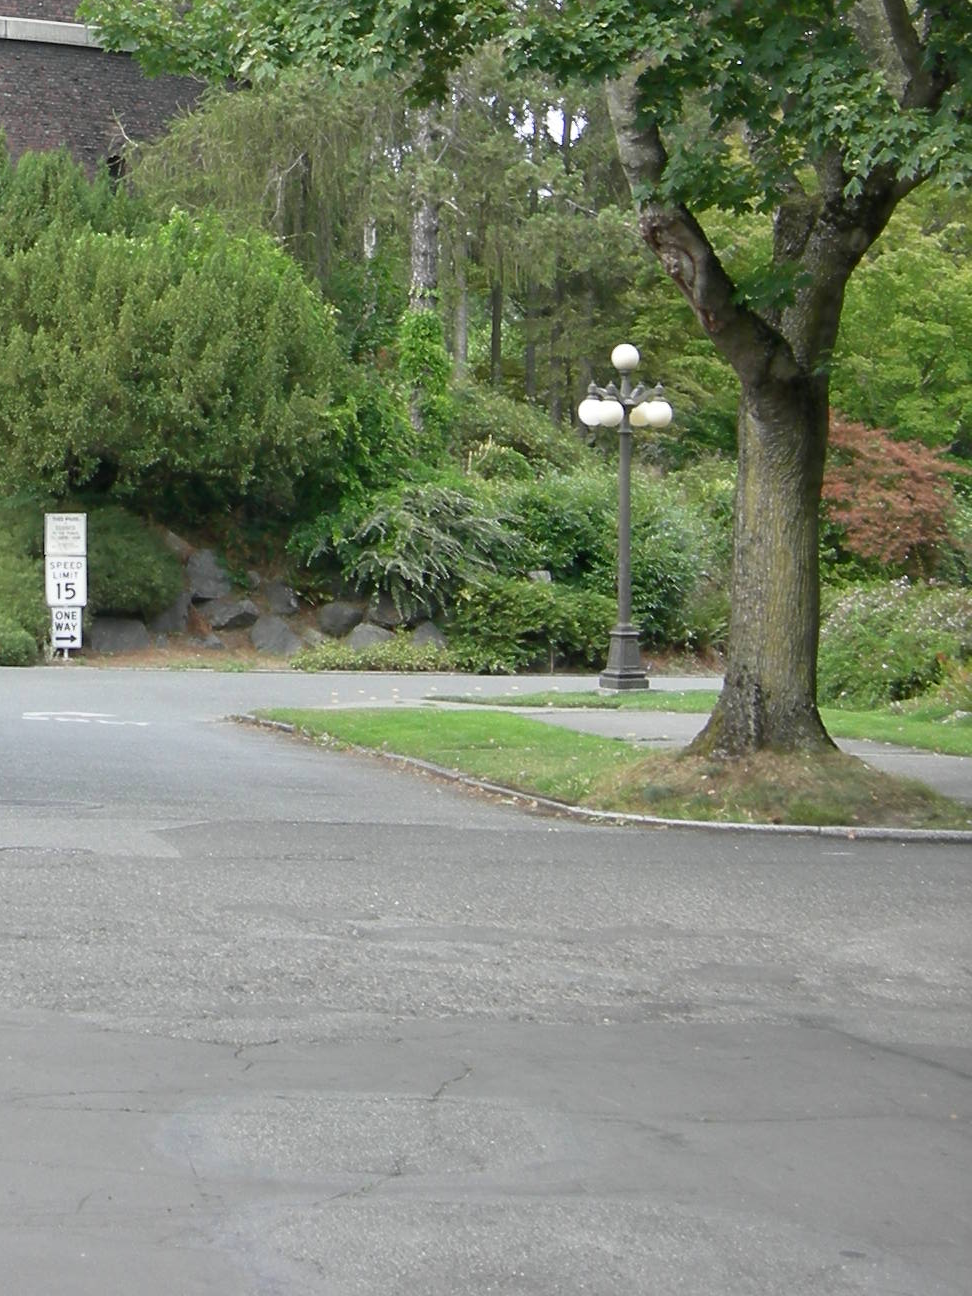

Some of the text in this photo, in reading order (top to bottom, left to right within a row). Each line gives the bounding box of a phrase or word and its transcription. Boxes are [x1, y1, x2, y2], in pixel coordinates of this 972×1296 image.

[50, 562, 82, 570] SPEED
[52, 571, 78, 579] LIMIT
[56, 582, 76, 600] 15
[55, 611, 77, 620] ONE
[54, 622, 77, 631] WAY
